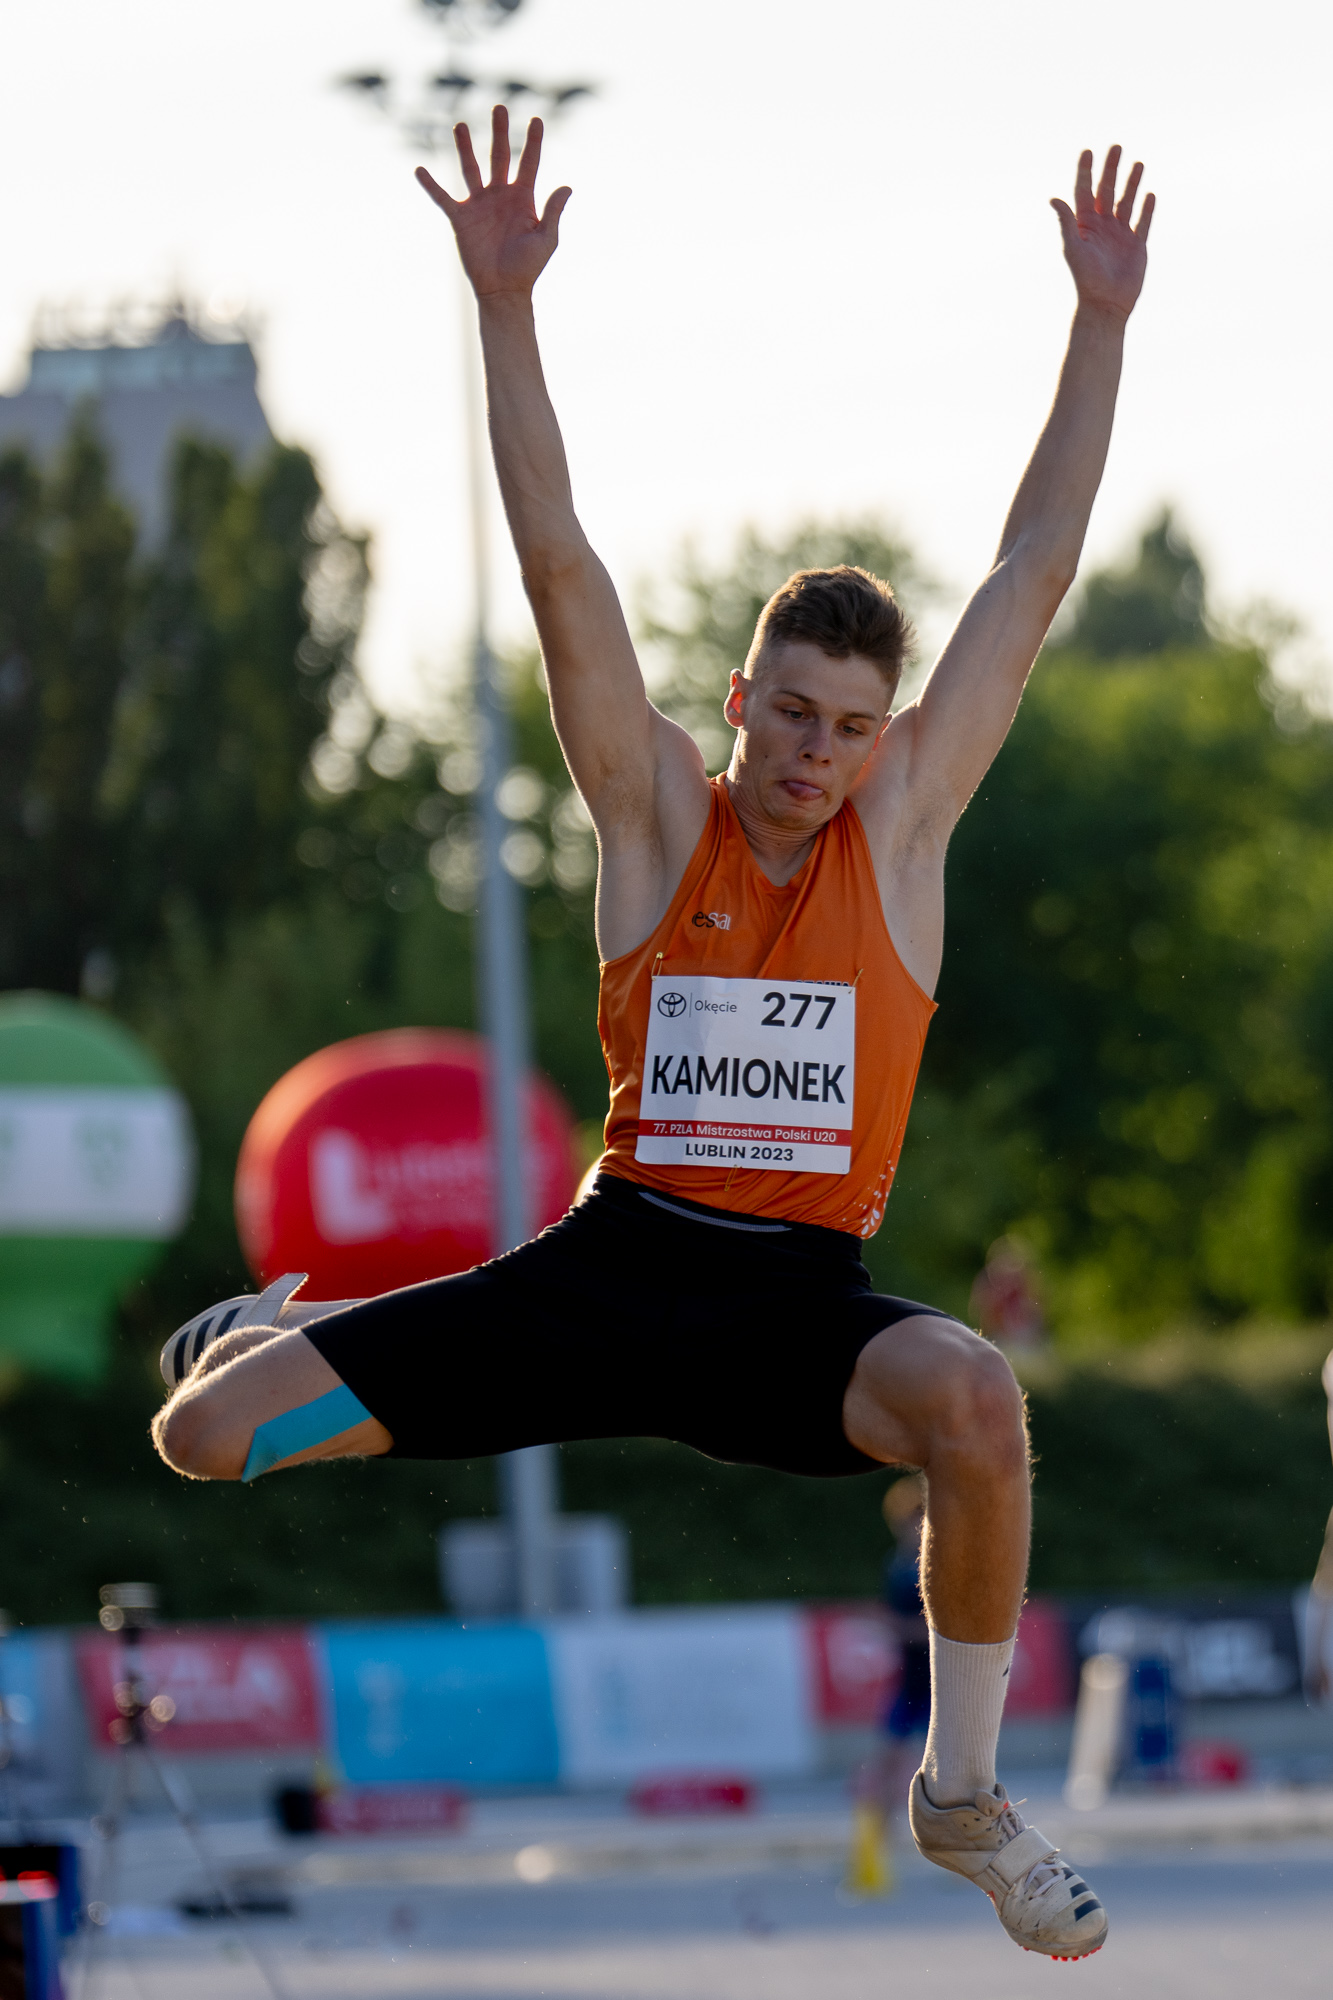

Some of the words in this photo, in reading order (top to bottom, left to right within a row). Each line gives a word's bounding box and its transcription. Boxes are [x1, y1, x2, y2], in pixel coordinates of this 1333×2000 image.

[694, 1000, 738, 1014] Okęcie
[761, 991, 836, 1030] 277
[651, 1055, 846, 1104] KAMIONEK
[653, 1123, 668, 1134] 77.
[670, 1123, 693, 1135] PZLA
[696, 1124, 772, 1139] Mistrzostwa
[774, 1129, 811, 1141] Polski
[813, 1131, 837, 1143] U20
[685, 1143, 746, 1159] LUBLIN
[750, 1146, 794, 1161] 2023
